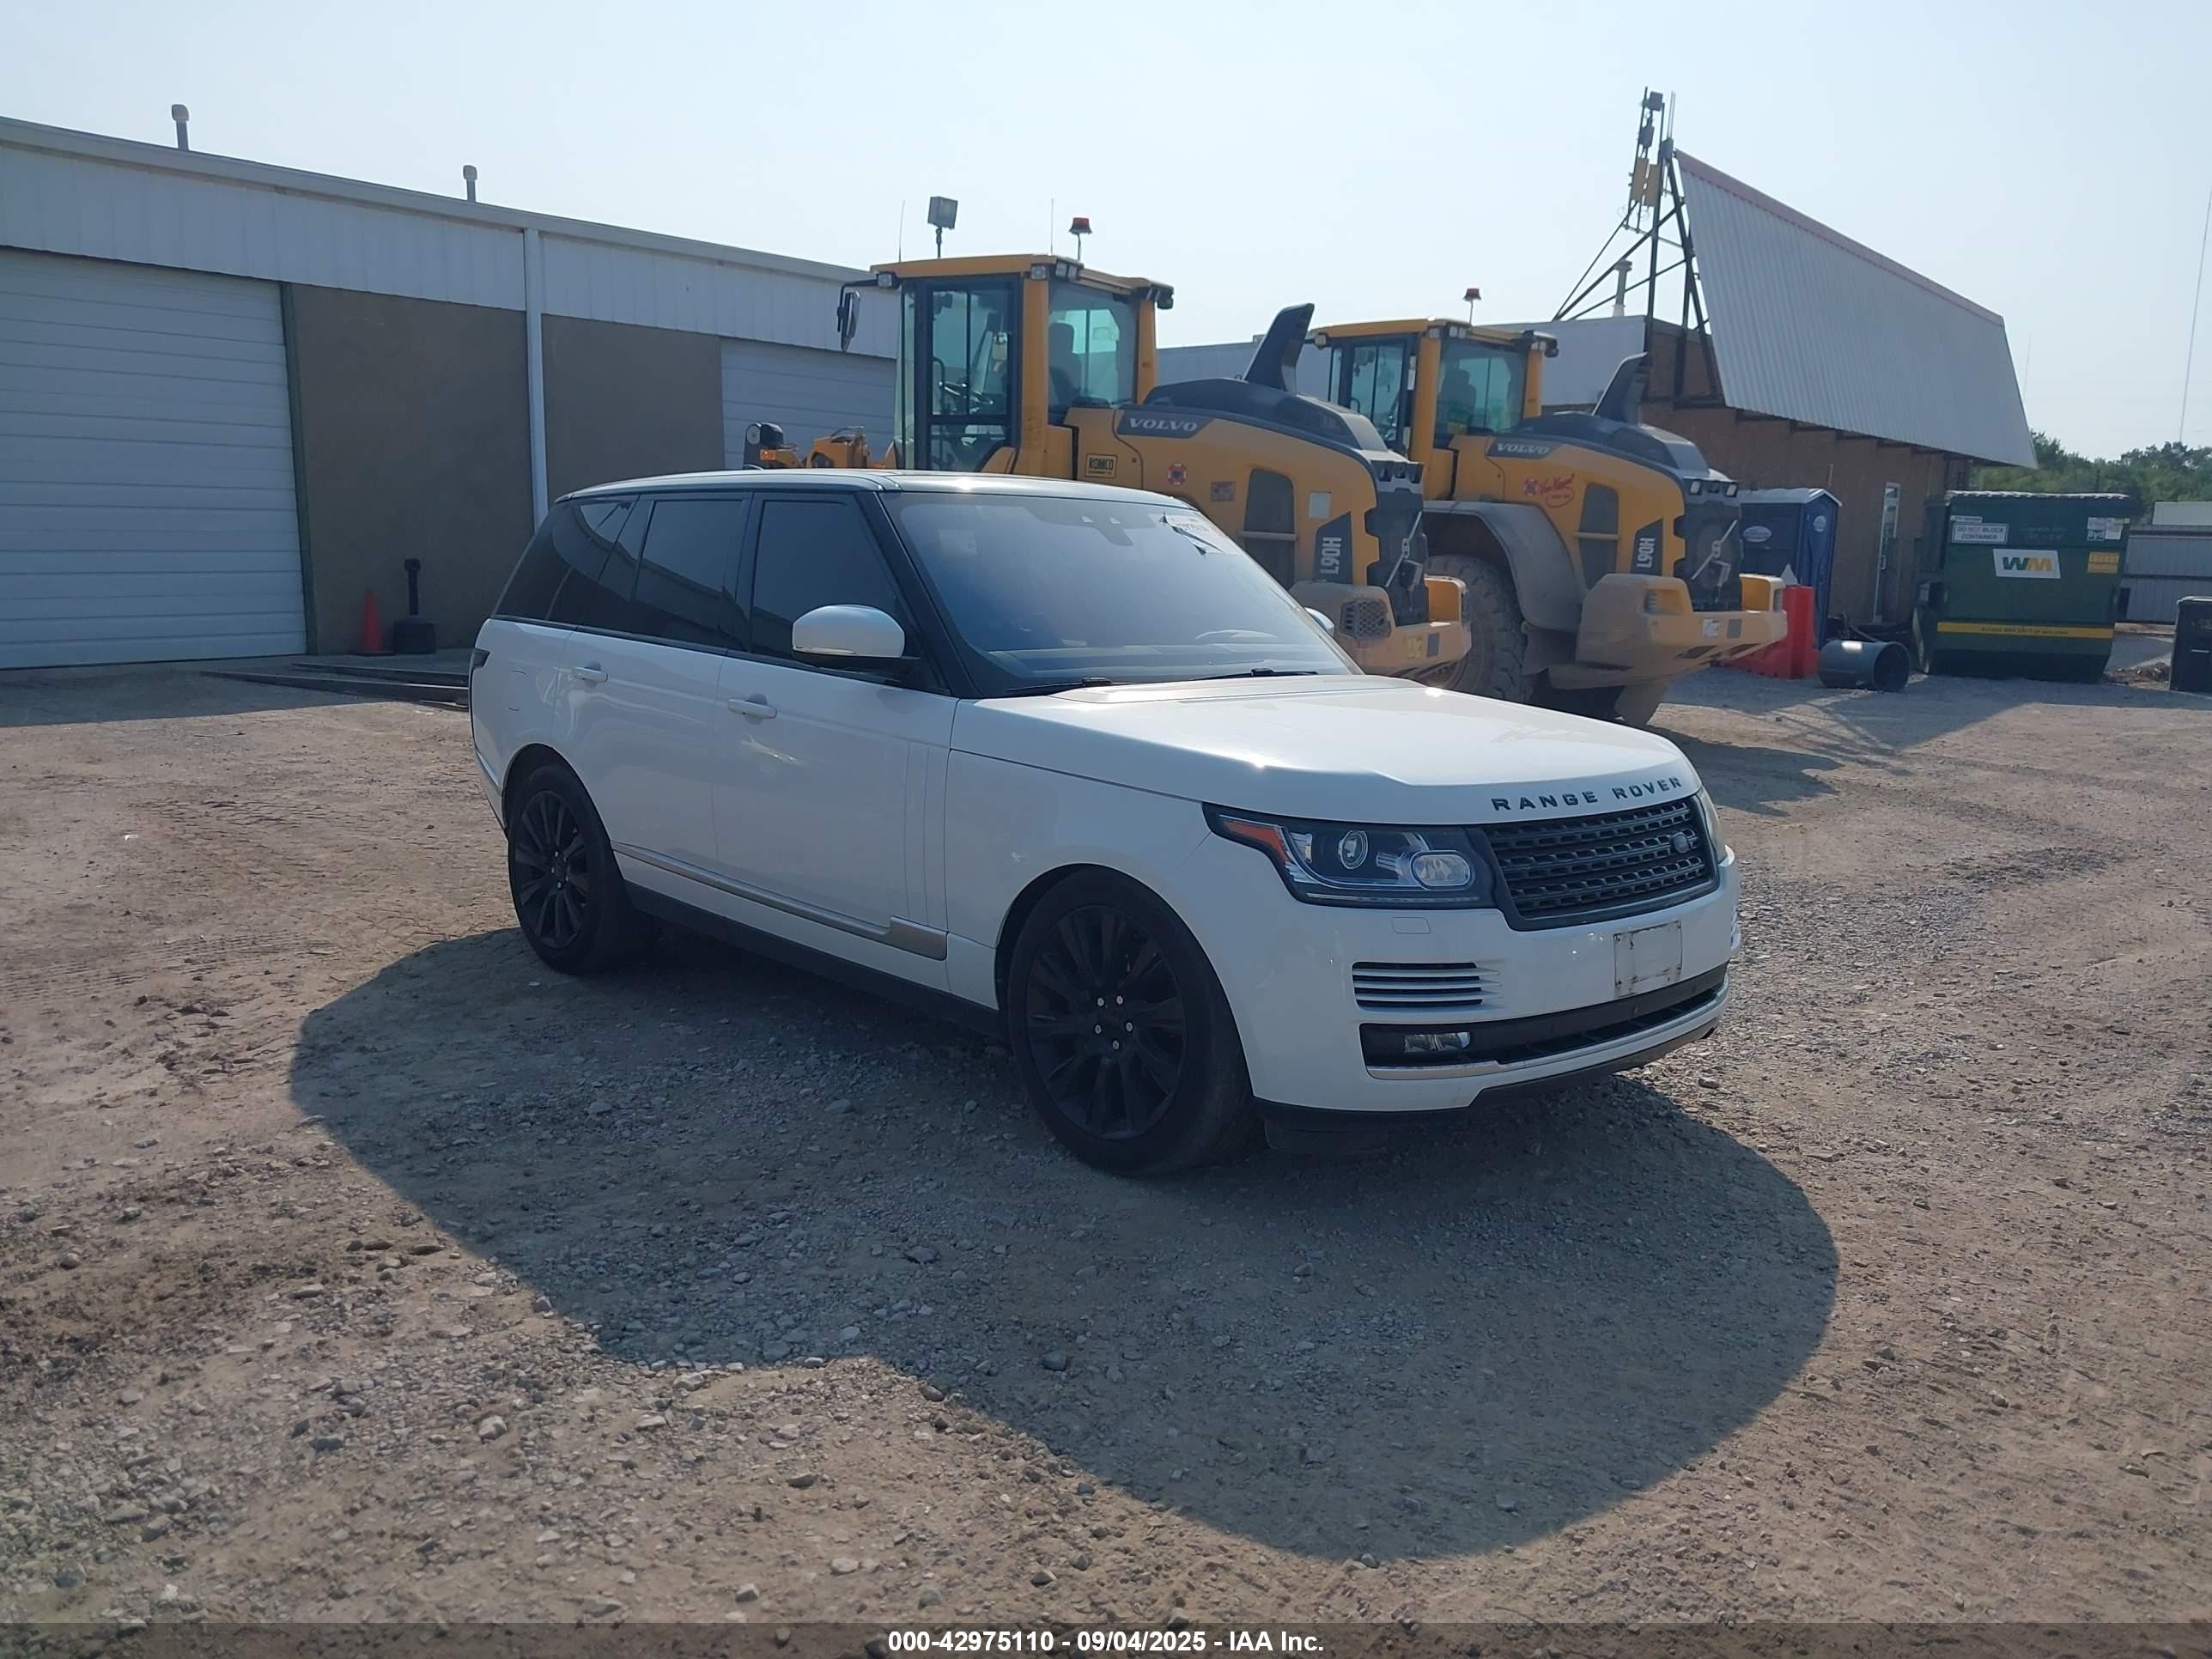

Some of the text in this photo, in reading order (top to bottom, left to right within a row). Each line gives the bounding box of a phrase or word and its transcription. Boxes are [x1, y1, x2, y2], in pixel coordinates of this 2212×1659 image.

[1129, 417, 1198, 432] VOLVO
[1497, 442, 1550, 454] VOLVO
[1089, 457, 1115, 471] ROMCO
[1320, 536, 1342, 575] L90H
[1636, 538, 1656, 568] L90H
[2002, 556, 2052, 572] WM
[1491, 776, 1682, 811] RANGE ROVER
